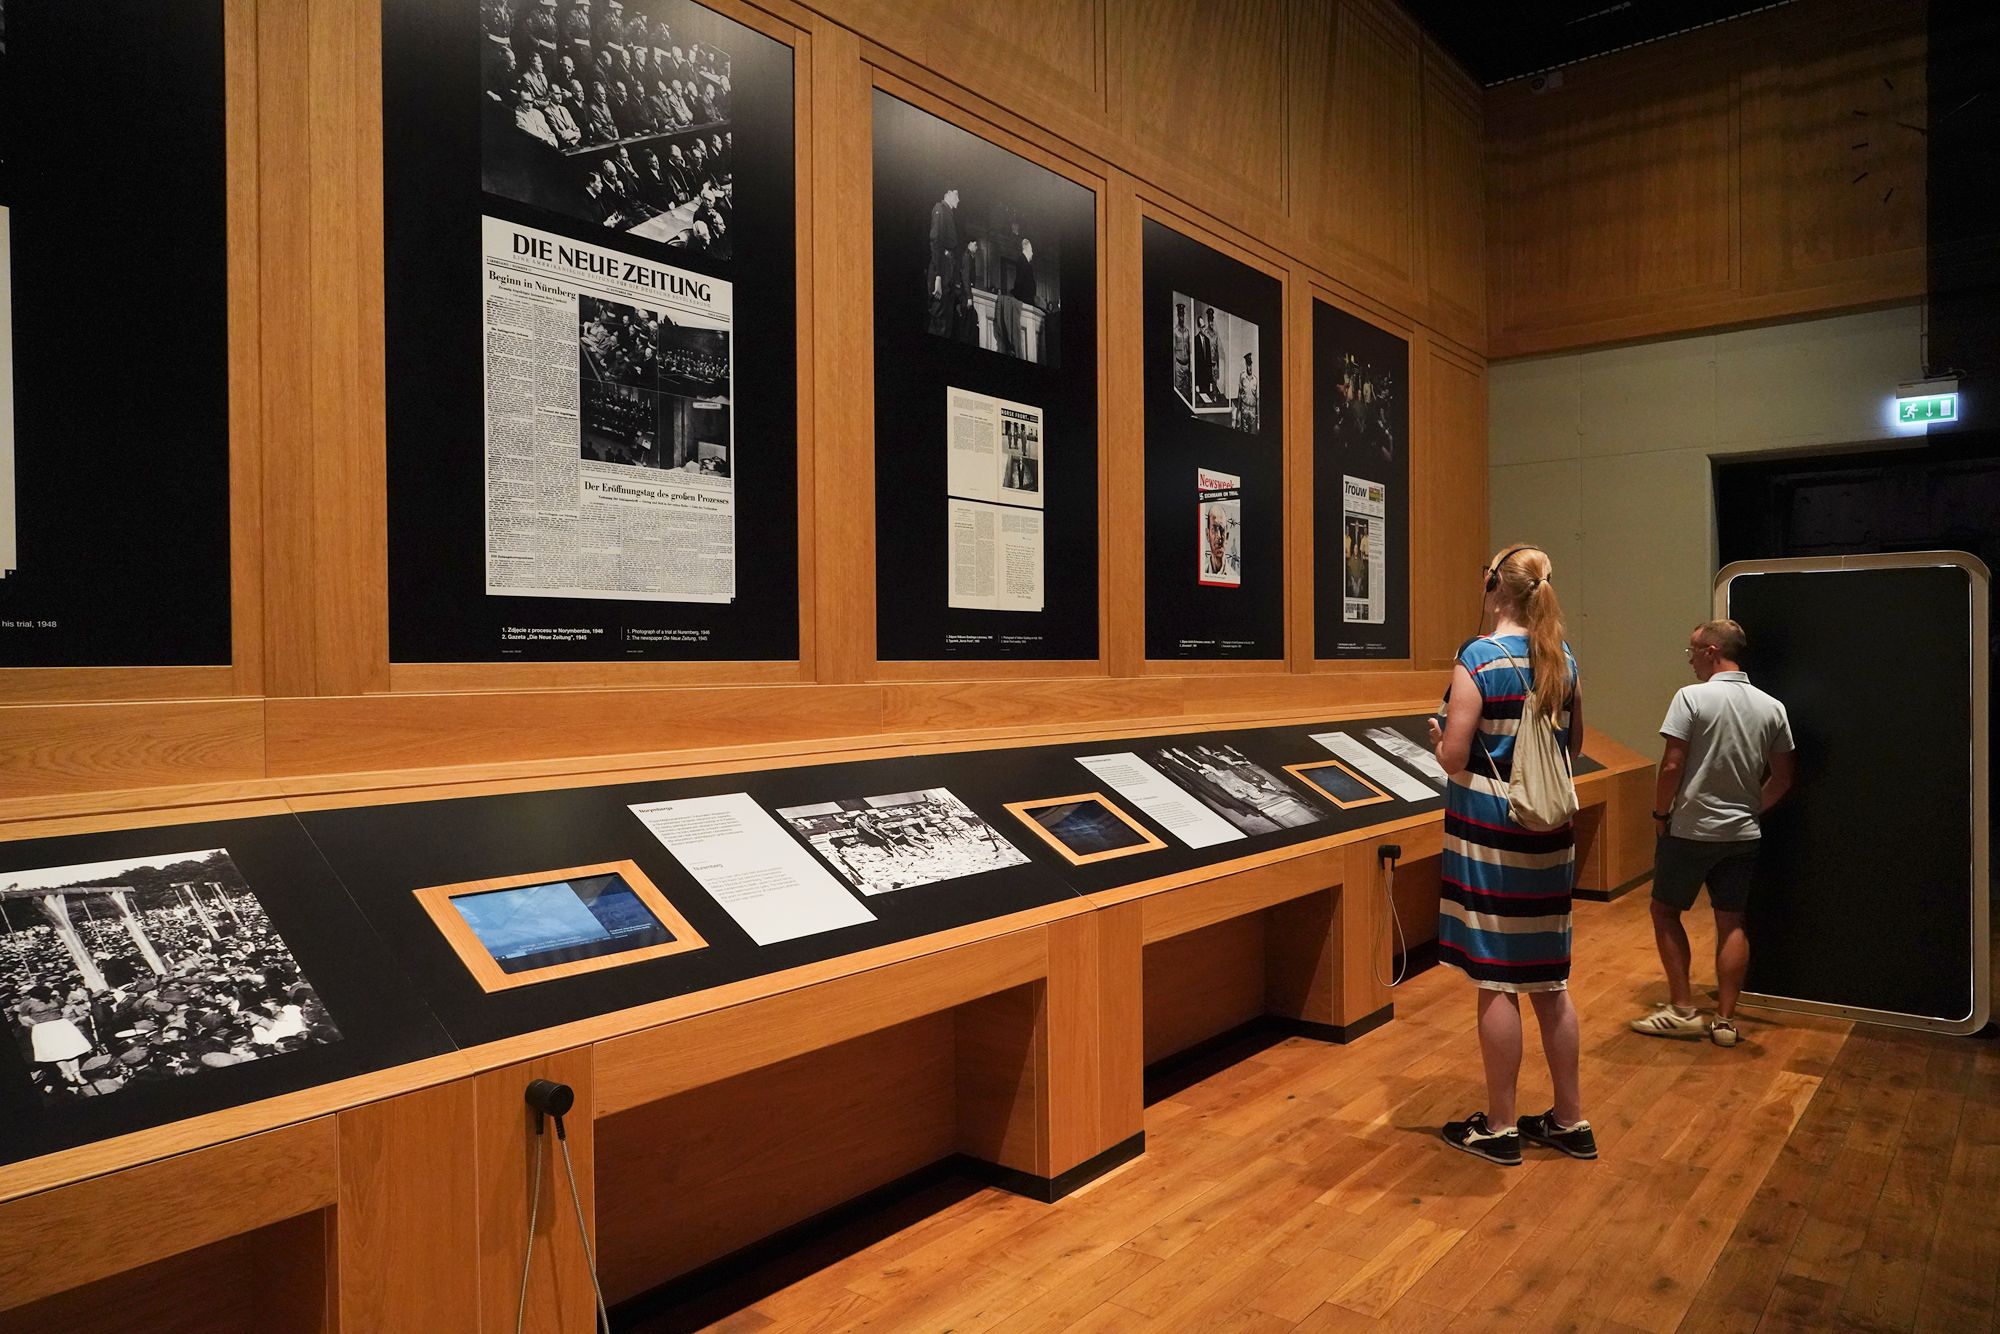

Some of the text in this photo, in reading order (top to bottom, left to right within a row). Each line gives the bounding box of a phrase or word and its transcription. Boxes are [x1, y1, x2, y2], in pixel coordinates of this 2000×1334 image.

[513, 233, 552, 262] DIE
[558, 245, 619, 279] NEUE
[623, 262, 711, 302] ZEITUNG
[489, 270, 521, 286] Beginn
[523, 279, 533, 289] in
[535, 281, 577, 301] Nürnberg
[1200, 473, 1235, 489] Newsweek
[1344, 481, 1368, 498] Trouw
[584, 481, 600, 492] Der
[602, 483, 655, 498] Eröffnungstag
[657, 489, 669, 498] des
[671, 493, 696, 502] großen
[697, 494, 729, 504] Prozesses
[1, 620, 57, 629] his trial, 1948
